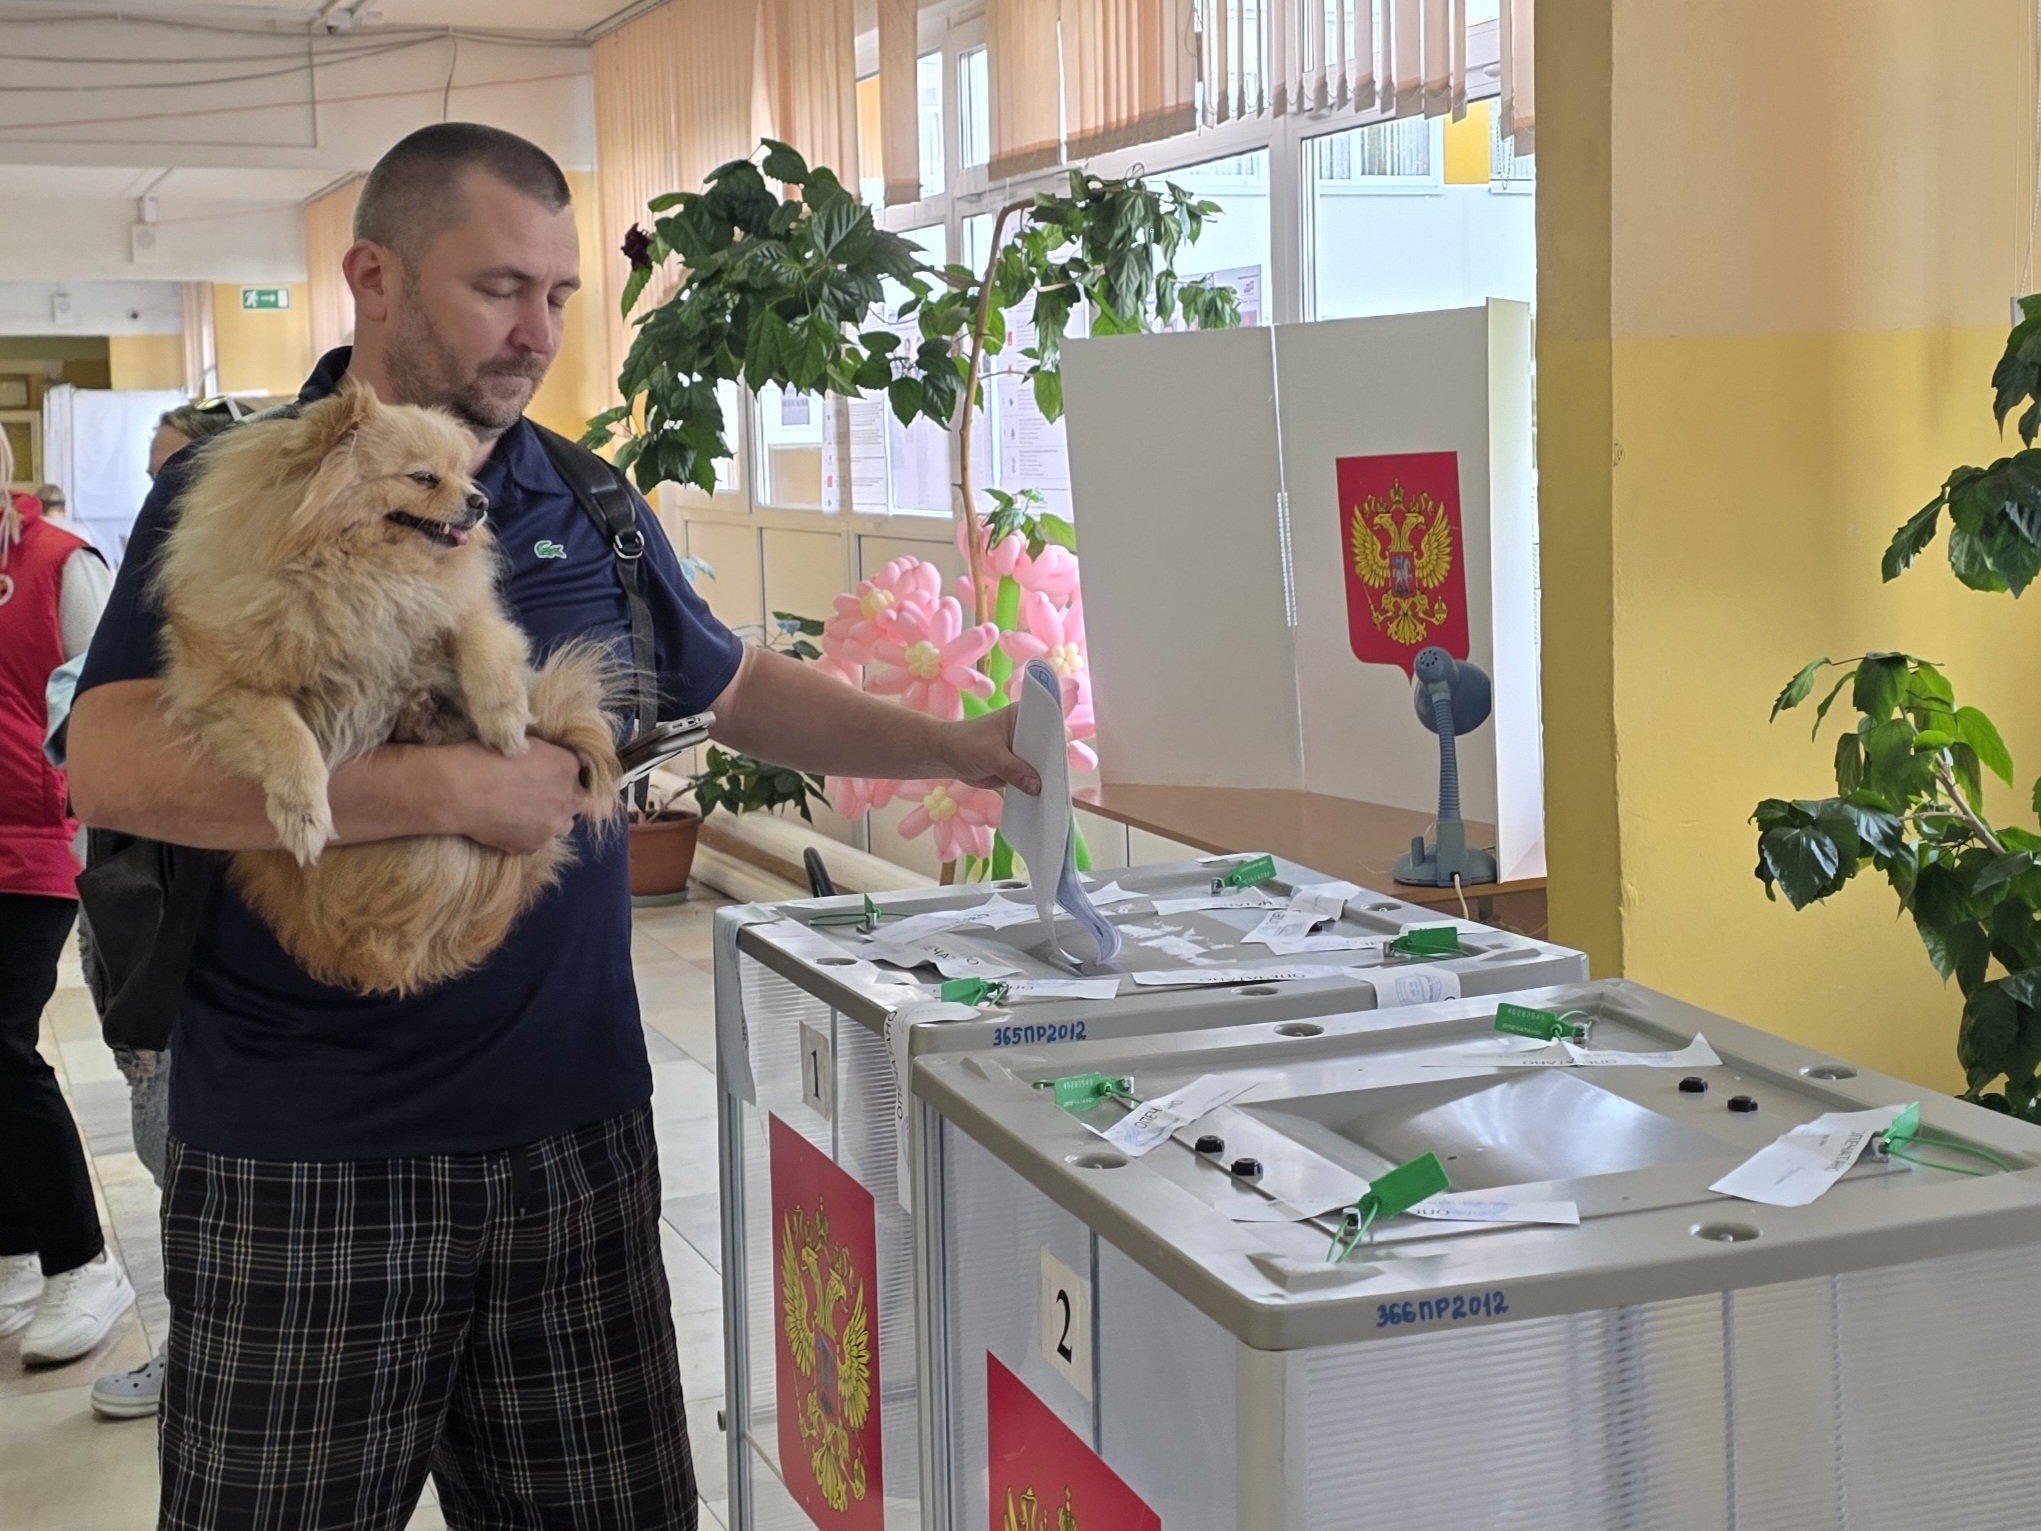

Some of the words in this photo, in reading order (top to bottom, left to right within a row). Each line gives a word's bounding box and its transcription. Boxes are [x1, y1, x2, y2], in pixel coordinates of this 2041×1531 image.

[993, 1021, 1087, 1047] 365ПР2012
[811, 1049, 821, 1100] 1
[1056, 1289, 1073, 1365] 2
[1376, 1291, 1509, 1328] 366ПР2012
